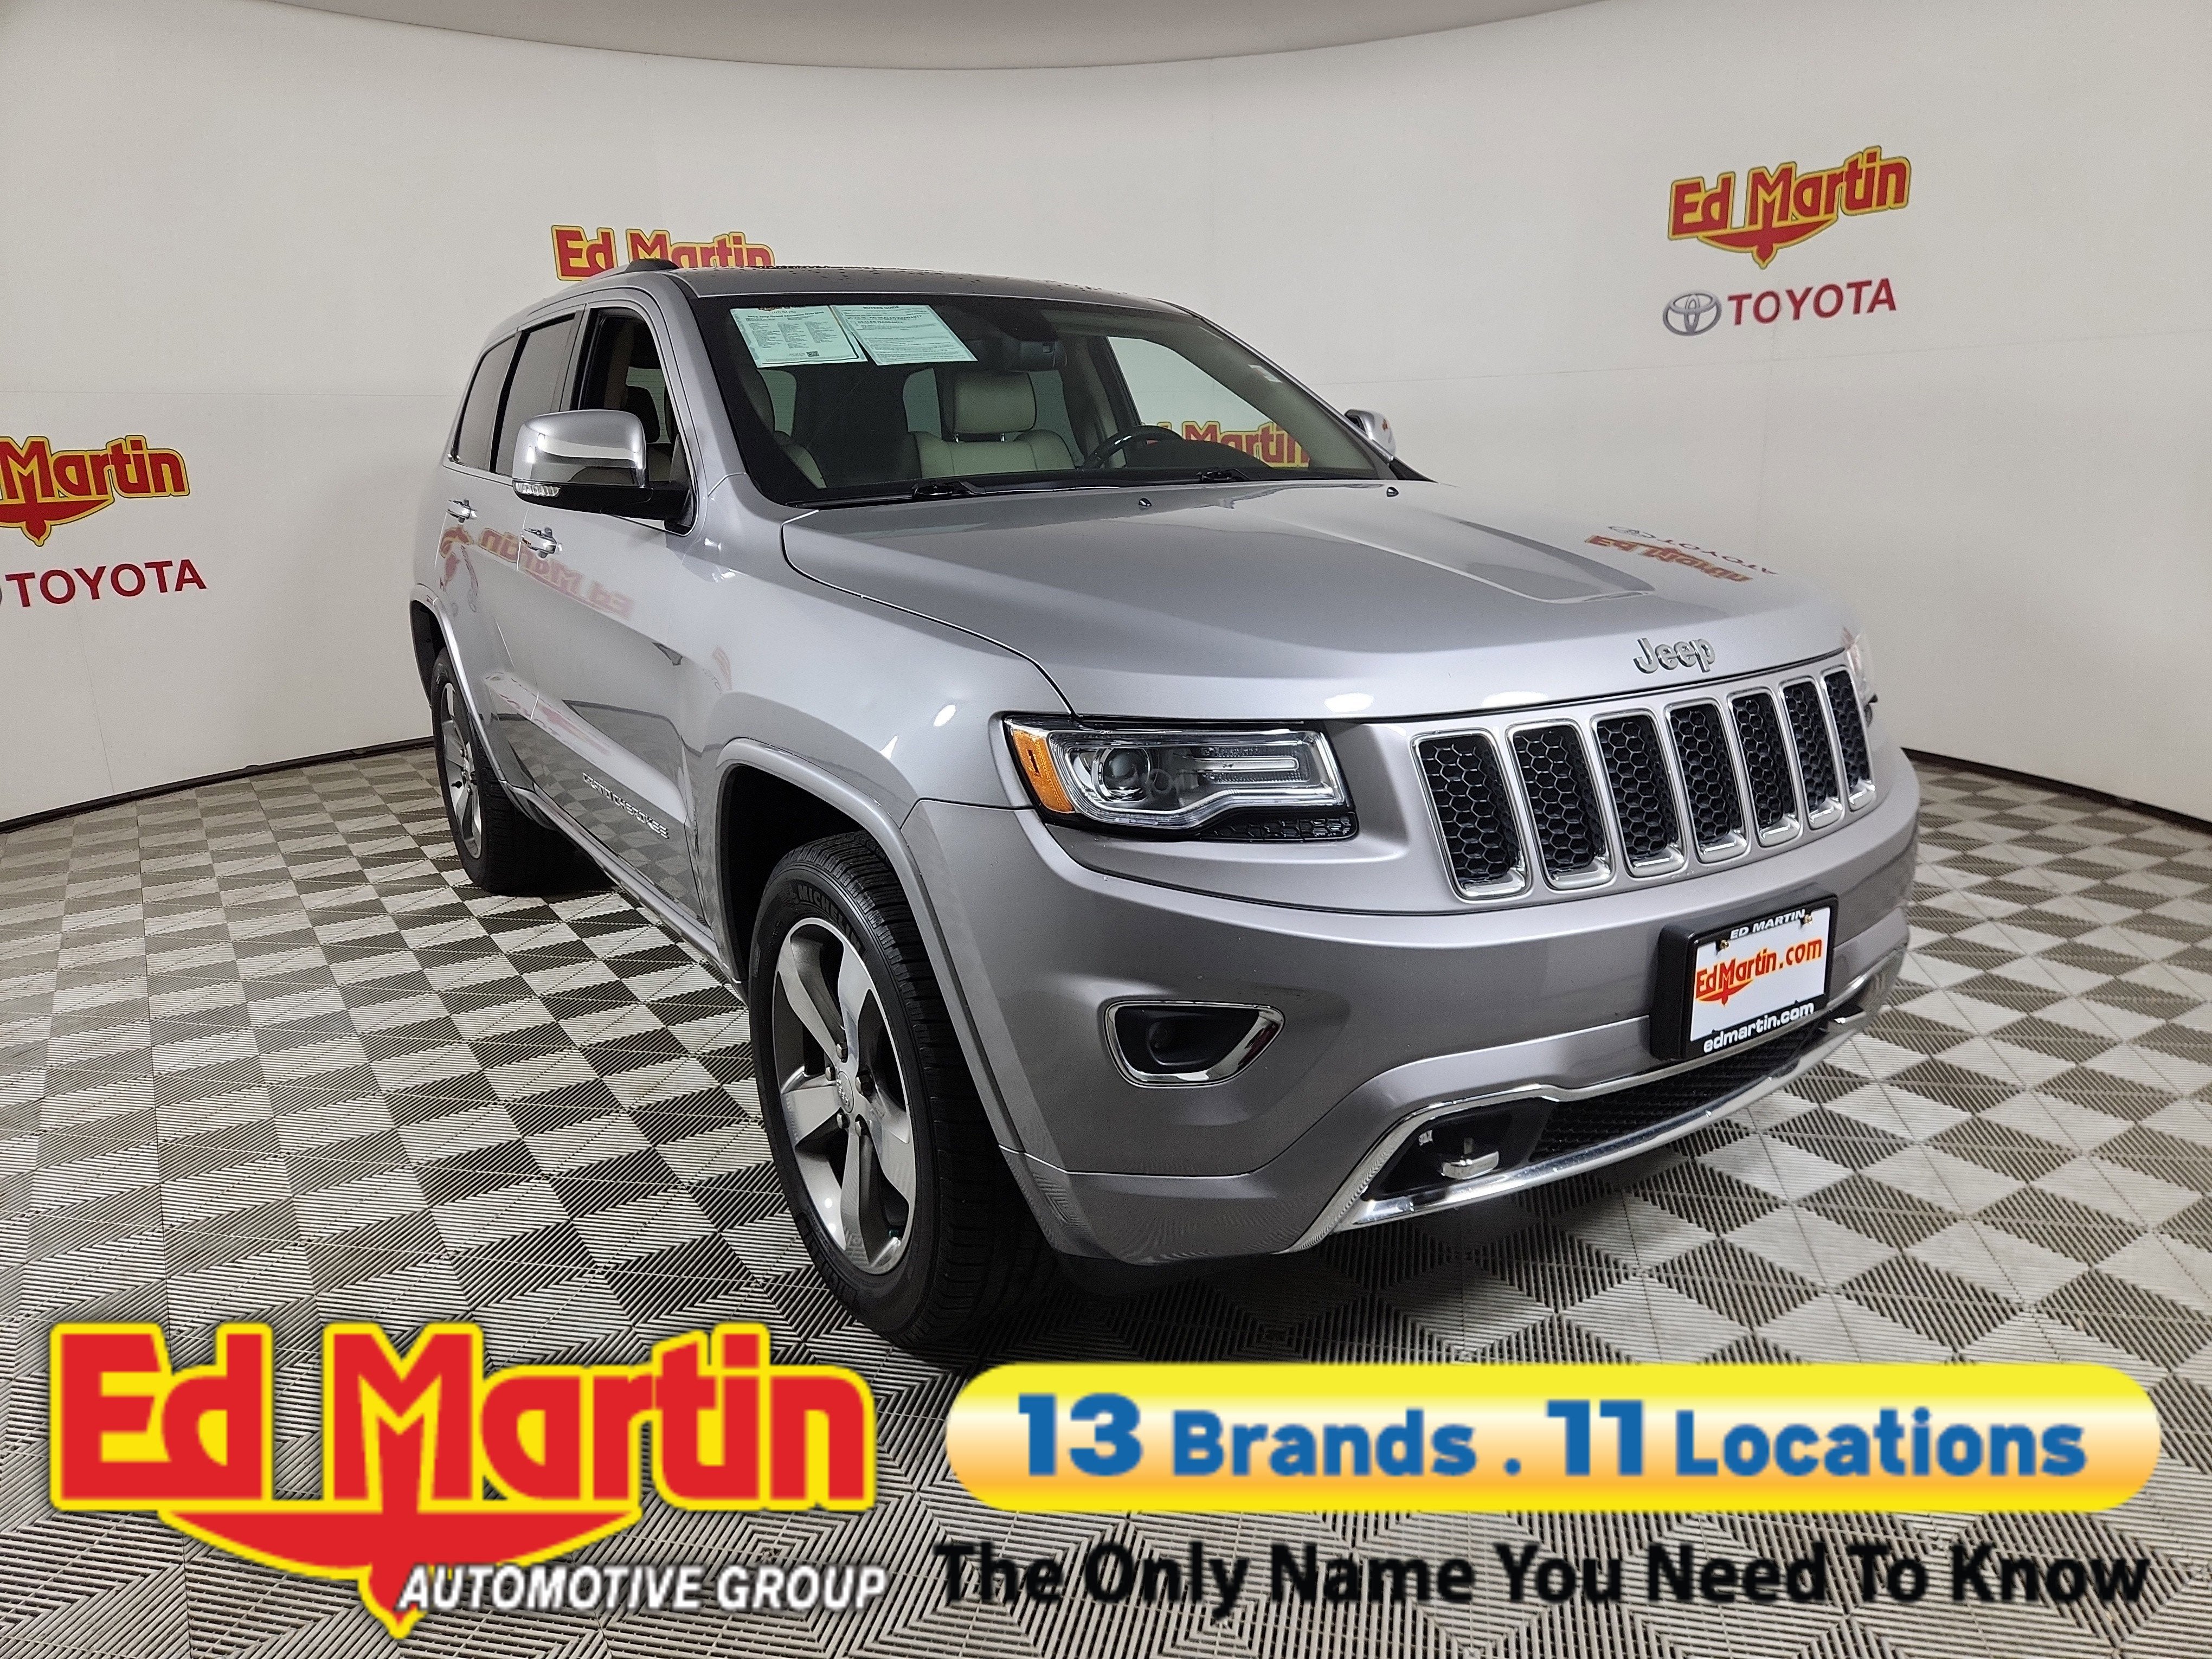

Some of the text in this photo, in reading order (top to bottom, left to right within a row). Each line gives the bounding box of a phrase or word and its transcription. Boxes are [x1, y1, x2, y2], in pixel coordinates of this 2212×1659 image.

[1668, 146, 1911, 240] Ed Martin
[552, 225, 775, 280] Ed Martin
[1728, 278, 1896, 326] TOYOTA
[0, 435, 190, 498] Martin
[5, 559, 207, 607] TOYOTA
[1633, 638, 1715, 674] Jeep
[796, 884, 861, 953] MICHELIN
[1730, 909, 1806, 940] ED MARTIN
[1703, 1002, 1815, 1053] edmartin.com
